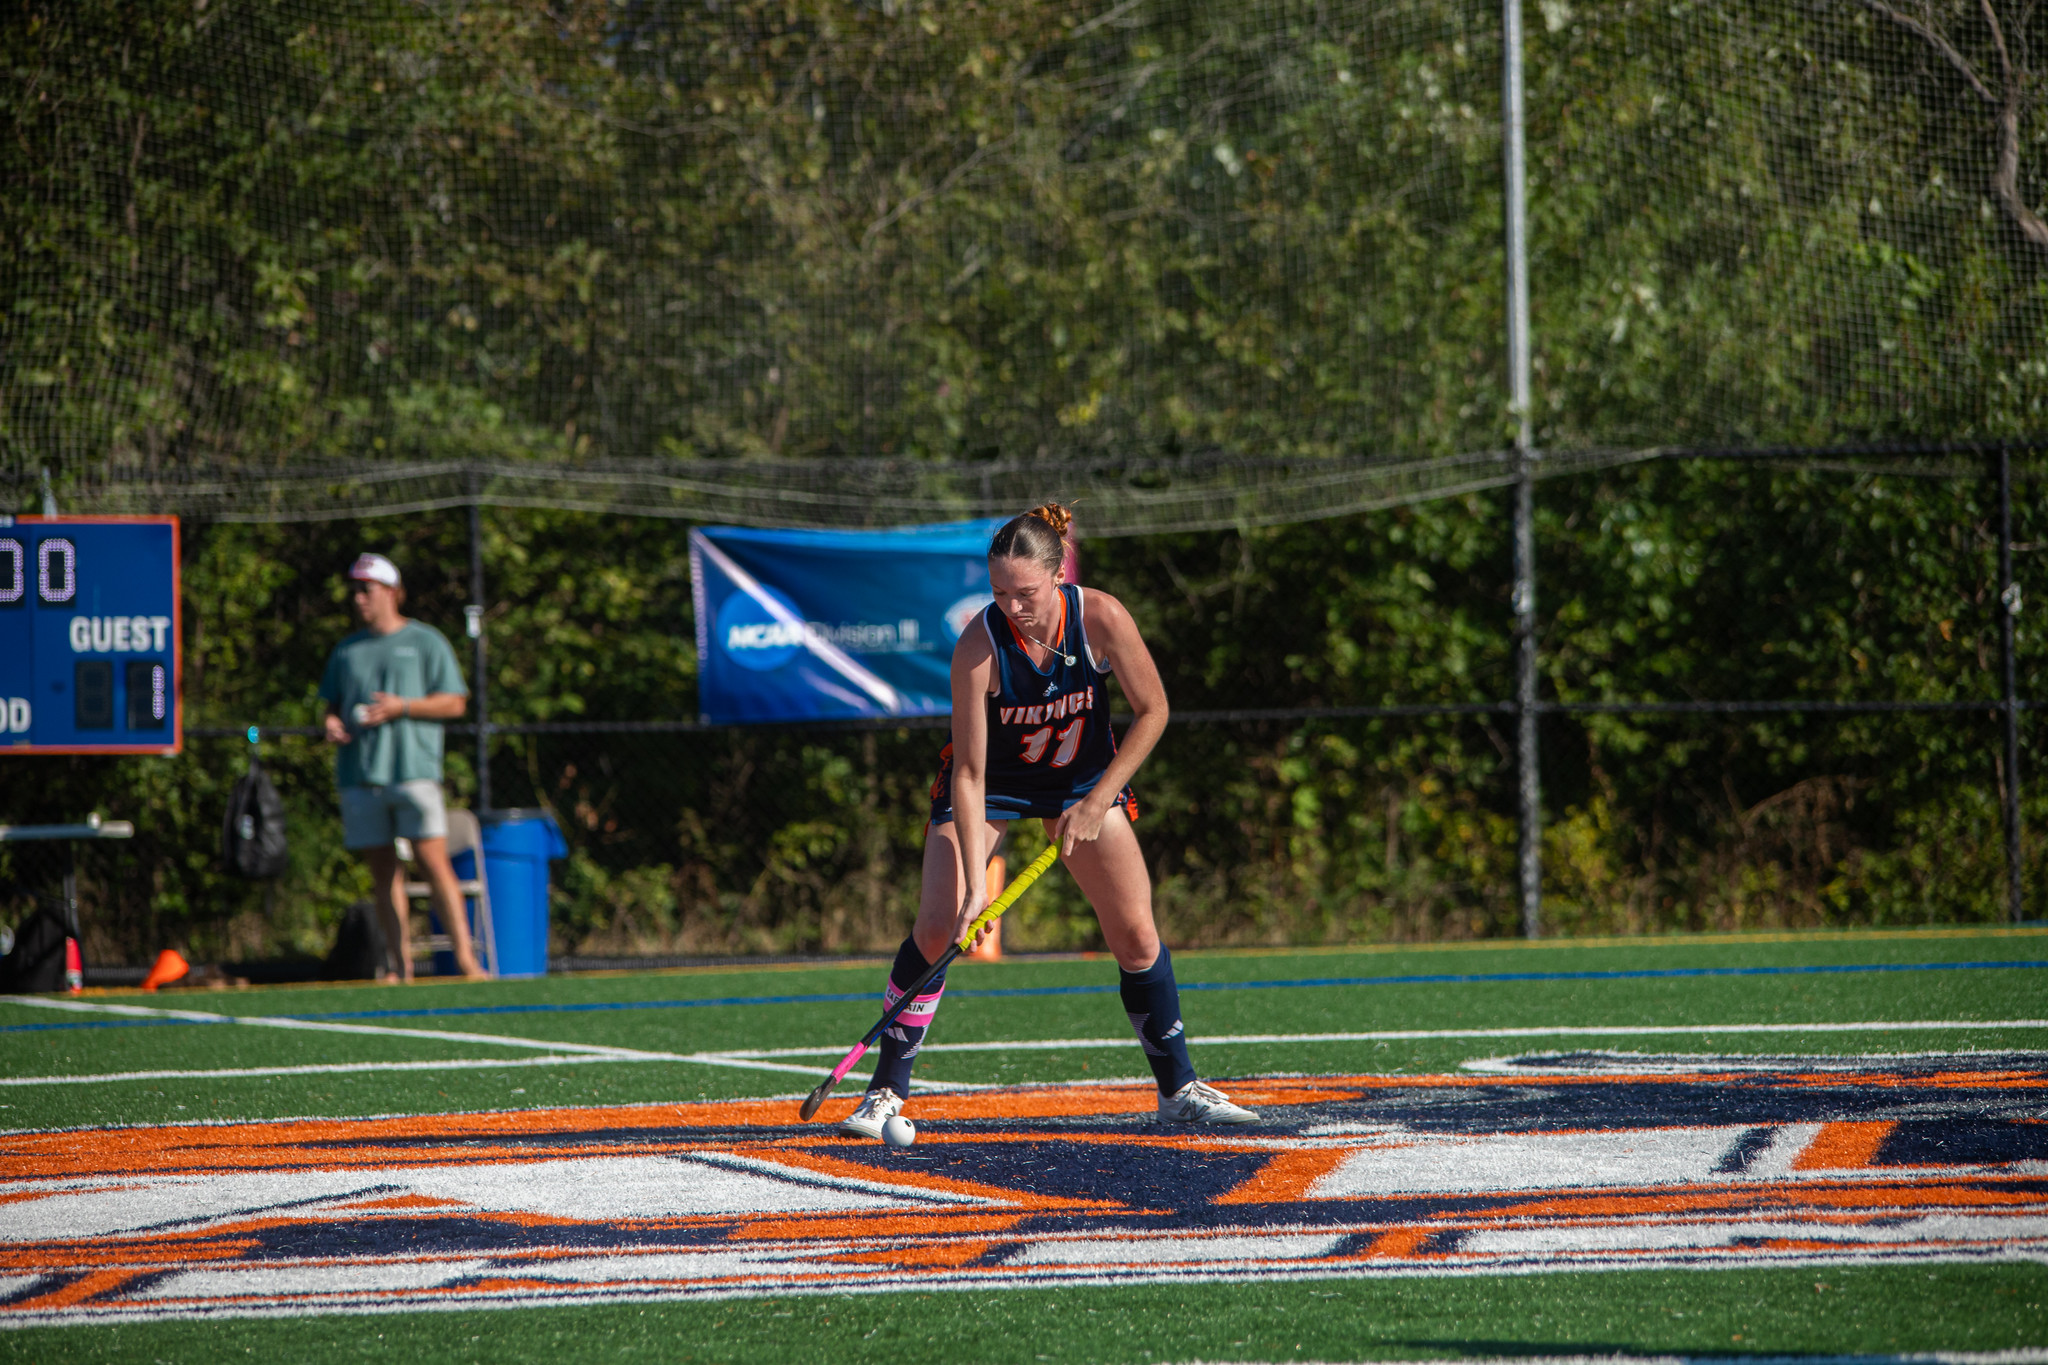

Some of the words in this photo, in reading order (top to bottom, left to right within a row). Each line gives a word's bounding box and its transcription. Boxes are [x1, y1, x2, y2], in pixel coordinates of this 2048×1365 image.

[70, 616, 170, 652] GUEST
[152, 665, 165, 720] 1
[1000, 686, 1094, 725] VIKINGS
[1019, 717, 1086, 768] 11
